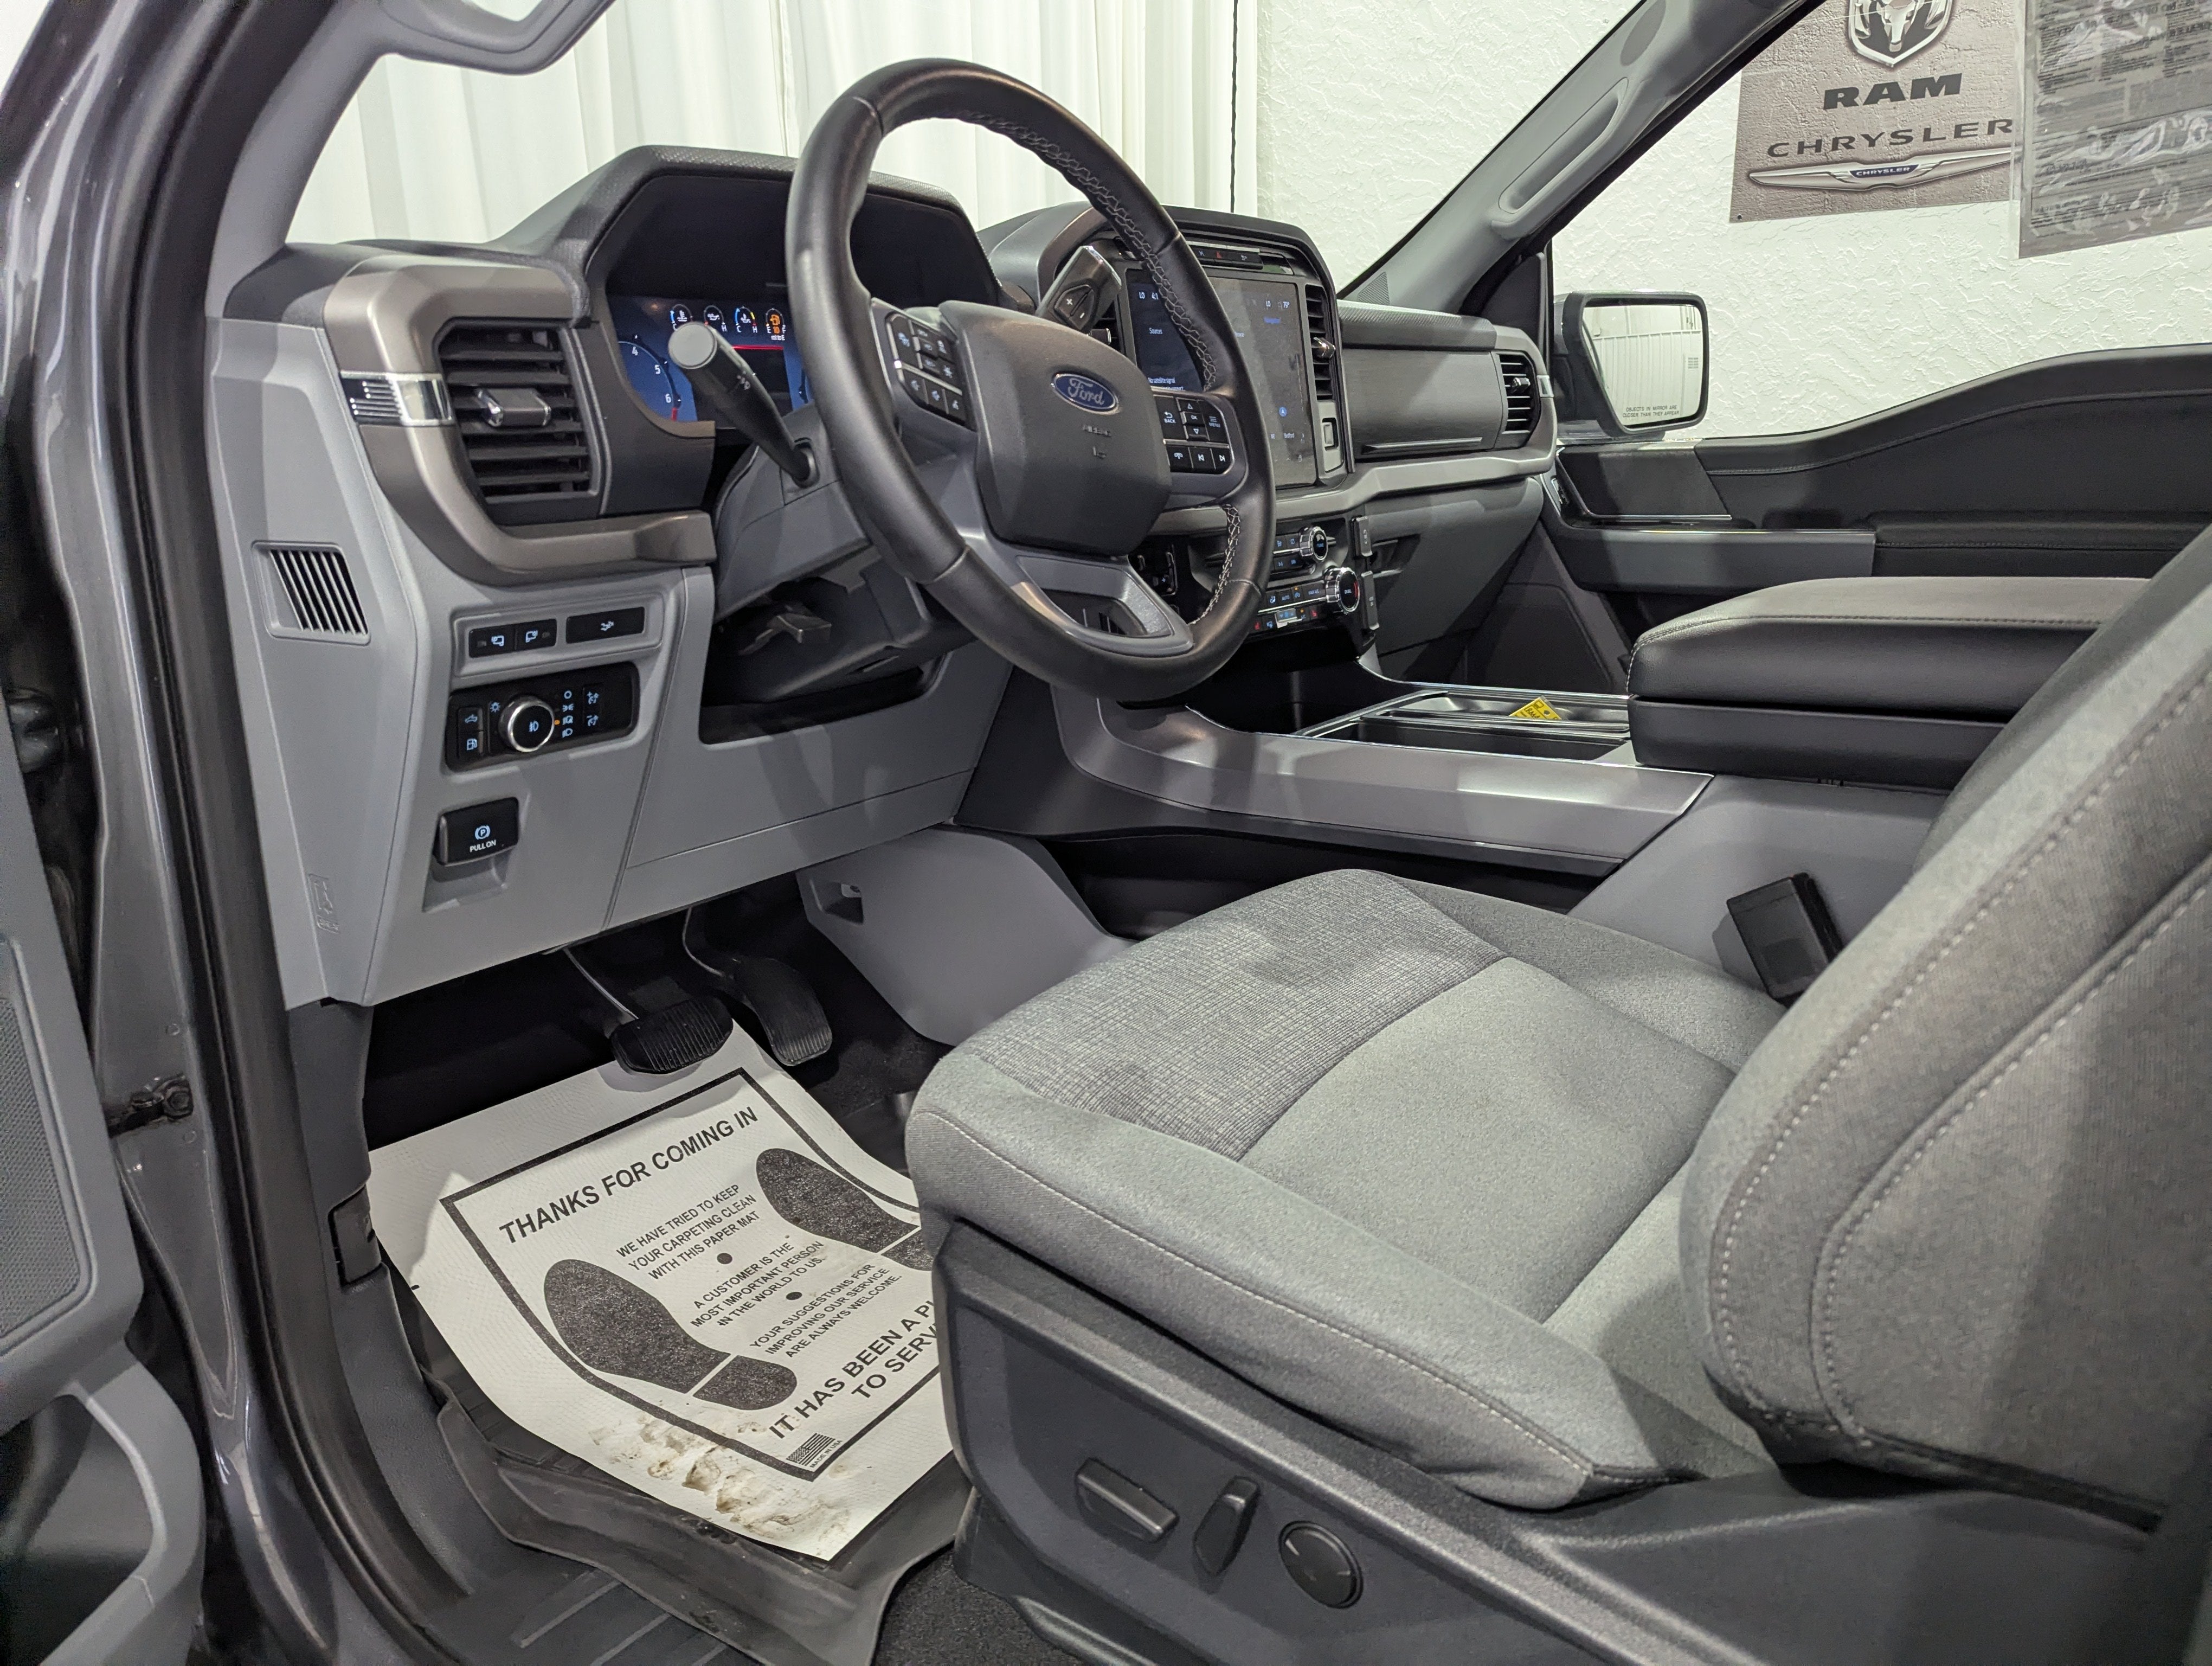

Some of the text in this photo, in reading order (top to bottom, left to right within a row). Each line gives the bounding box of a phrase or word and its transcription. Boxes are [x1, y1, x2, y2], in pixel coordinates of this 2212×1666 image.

[1823, 73, 1963, 110] RAM
[1767, 118, 2013, 158] CHRYSLER
[1856, 167, 1911, 176] CHRYSLER
[632, 346, 638, 356] 4
[654, 364, 661, 374] 5
[665, 393, 672, 403] 6
[1068, 377, 1105, 406] Ford
[470, 840, 497, 853] PULL ON
[499, 1106, 758, 1243] THANKS FOR COMING IN
[616, 1184, 740, 1258] WE HAVE TRIED TO KEEP
[628, 1194, 756, 1271] YOUR CARPETING CLEAN
[648, 1210, 760, 1280] WITH THIS PAPER MAT
[690, 1241, 824, 1327] MOST IMPORTANT PERSON
[693, 1242, 794, 1309] A CUSTOMER IS THE
[716, 1316, 733, 1327] IN
[729, 1301, 756, 1317] THE
[751, 1277, 792, 1303] WORLD
[789, 1267, 807, 1277] TO
[749, 1264, 876, 1348] YOUR SUGGESTIONS FOR
[764, 1268, 890, 1355] IMPROVING OUR SERVICE
[786, 1275, 902, 1357] ARE ALWAYS WELCOME.
[769, 1414, 795, 1439] IT
[794, 1377, 845, 1418] HAS
[841, 1329, 903, 1377] BEEN
[901, 1319, 921, 1332] A
[851, 1322, 937, 1398] TO SERV
[809, 1454, 827, 1468] MADE
[829, 1440, 843, 1449] USA
